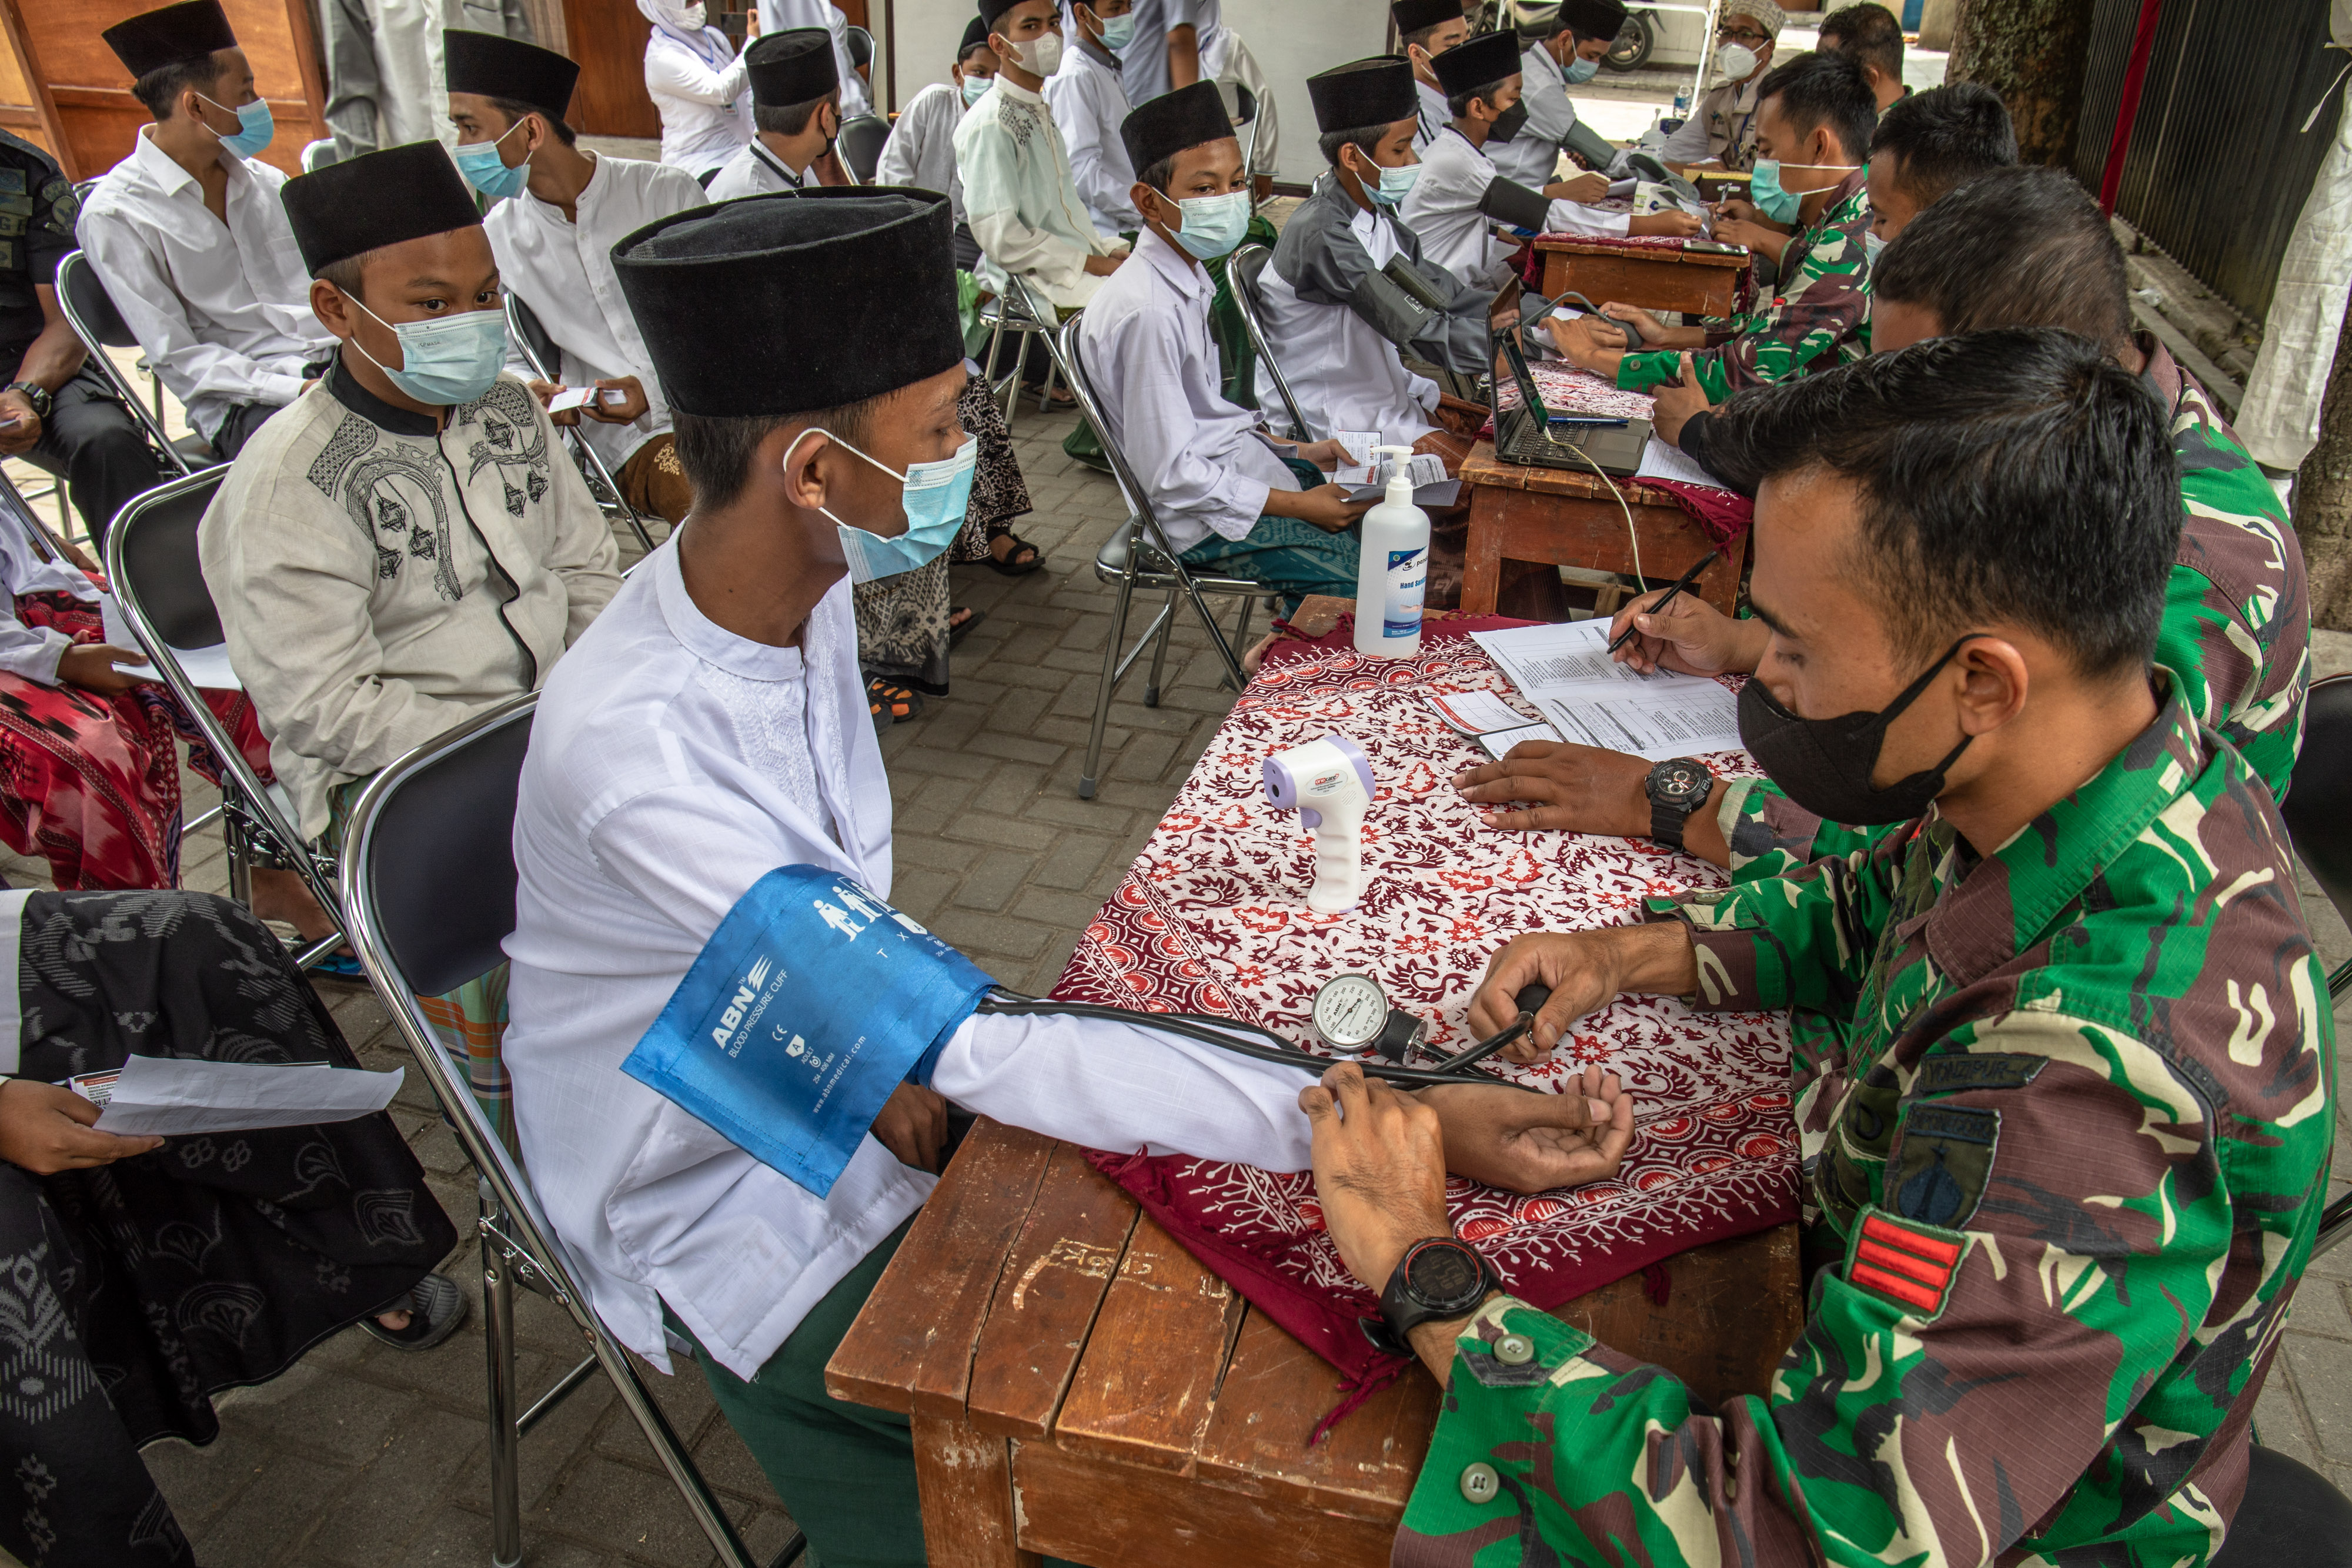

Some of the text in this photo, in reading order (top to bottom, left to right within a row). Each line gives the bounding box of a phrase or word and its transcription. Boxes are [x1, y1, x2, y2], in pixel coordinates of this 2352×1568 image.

[1400, 581, 1414, 589] Hand
[712, 985, 756, 1049] ABN
[729, 969, 787, 1058] BLOOD PRESSURE CUFF
[1334, 1003, 1342, 1016] ABN
[801, 1047, 814, 1065] ADULT
[826, 1052, 836, 1064] MM
[813, 1035, 866, 1114] www.abnmedical.com
